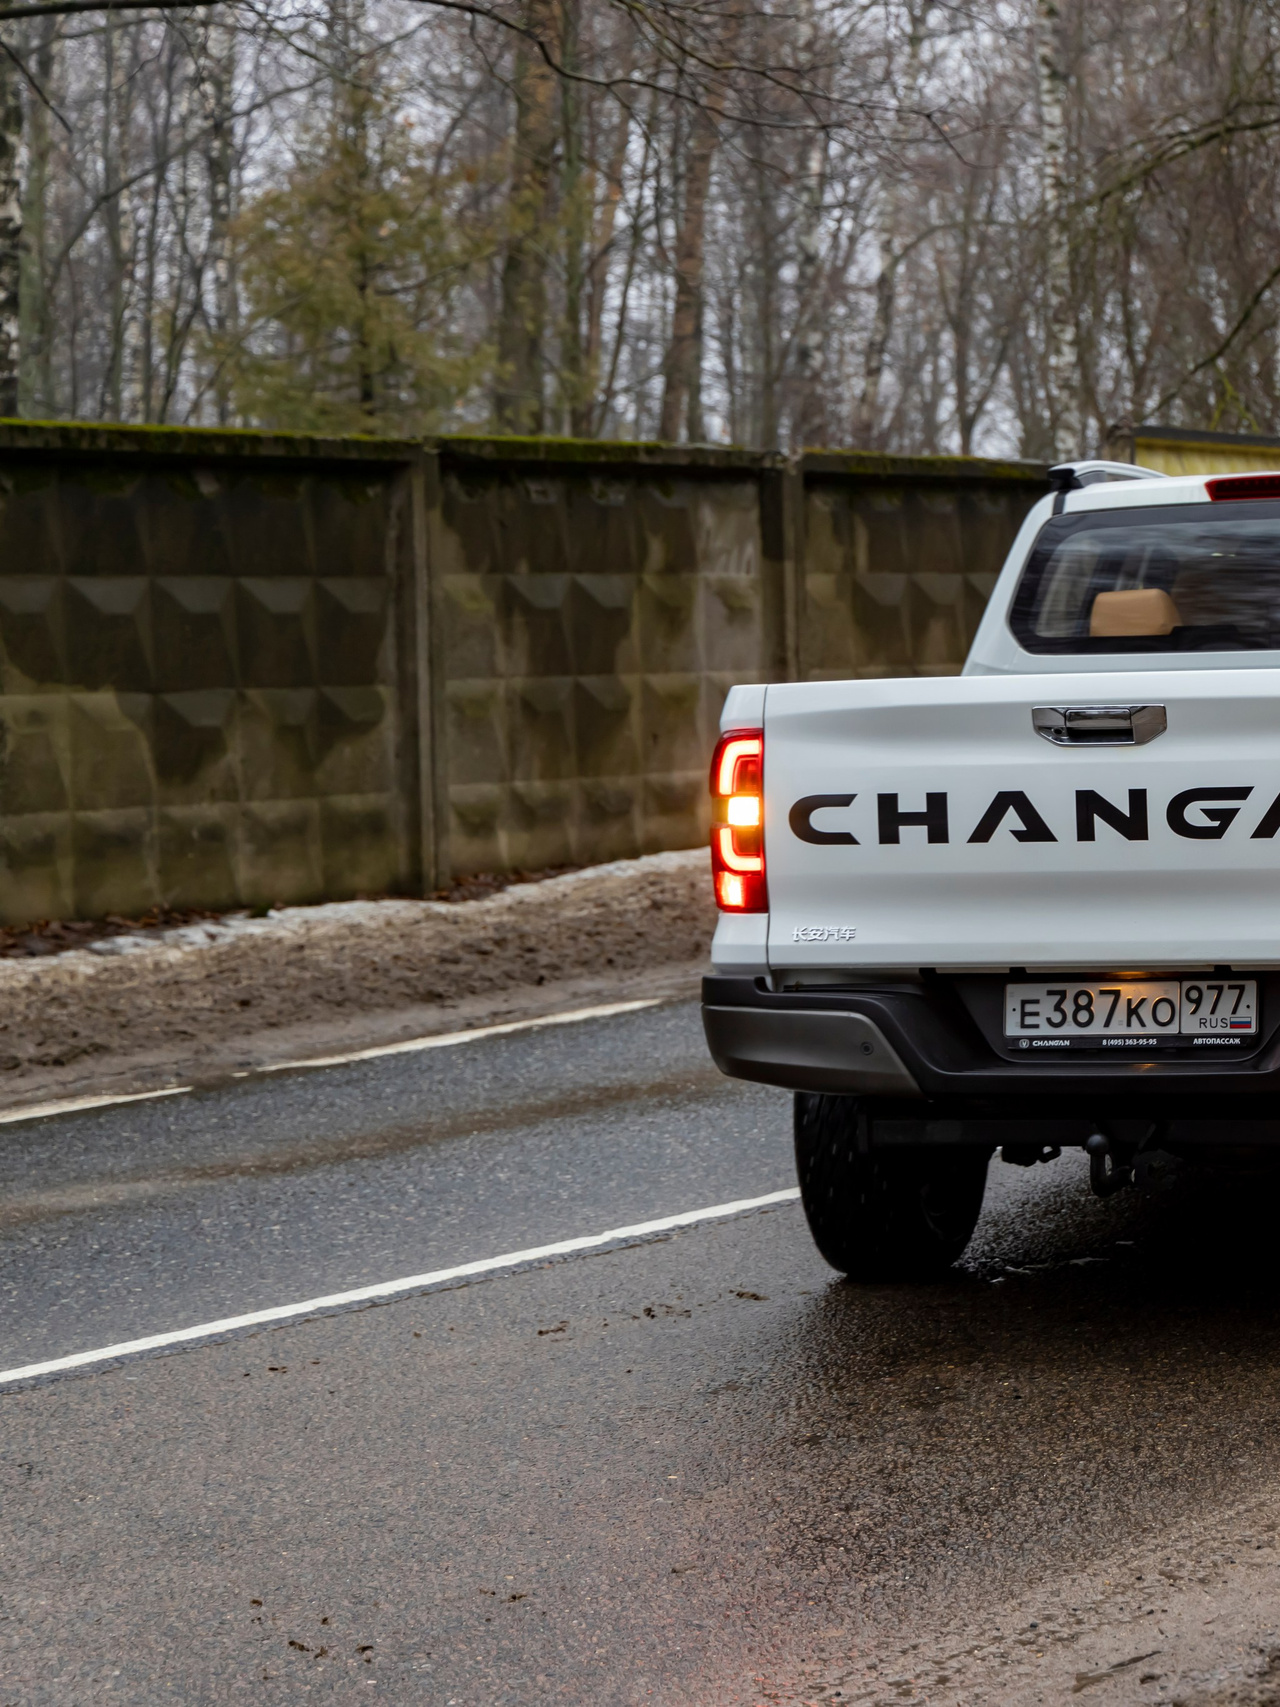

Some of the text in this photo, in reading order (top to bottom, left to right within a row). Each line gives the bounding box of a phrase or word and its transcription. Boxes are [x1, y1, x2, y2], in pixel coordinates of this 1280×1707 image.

[792, 926, 856, 942] 长安汽车
[1184, 984, 1246, 1015] 977
[1199, 1017, 1229, 1029] RUS
[1108, 1038, 1124, 1047] (495)
[1125, 1038, 1157, 1046] 363-95-95
[1193, 1037, 1241, 1045] АВТОПАССАЖ
